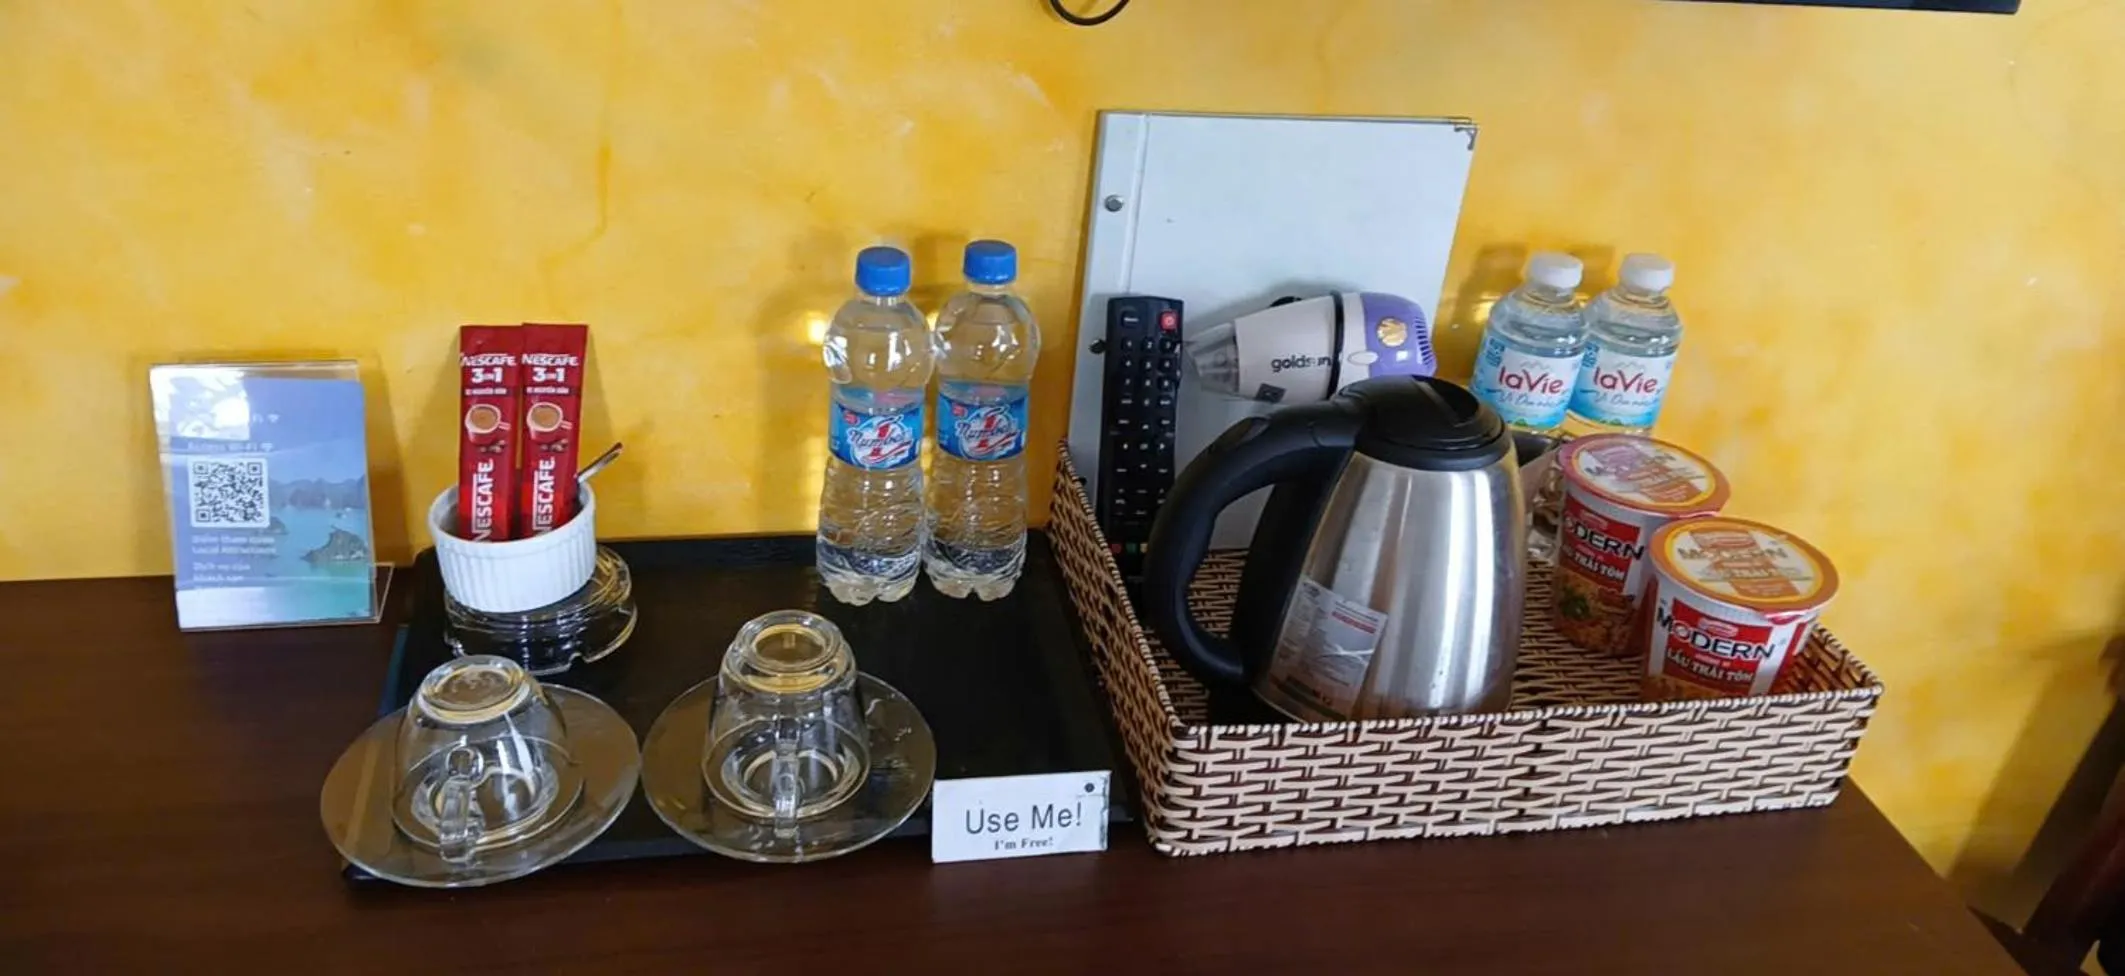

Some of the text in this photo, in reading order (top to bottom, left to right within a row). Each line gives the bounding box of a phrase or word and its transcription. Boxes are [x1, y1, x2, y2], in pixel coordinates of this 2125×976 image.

[1656, 607, 1776, 660] MODERN
[966, 801, 1082, 834] Use Me!
[994, 836, 1054, 850] I'm Free!
